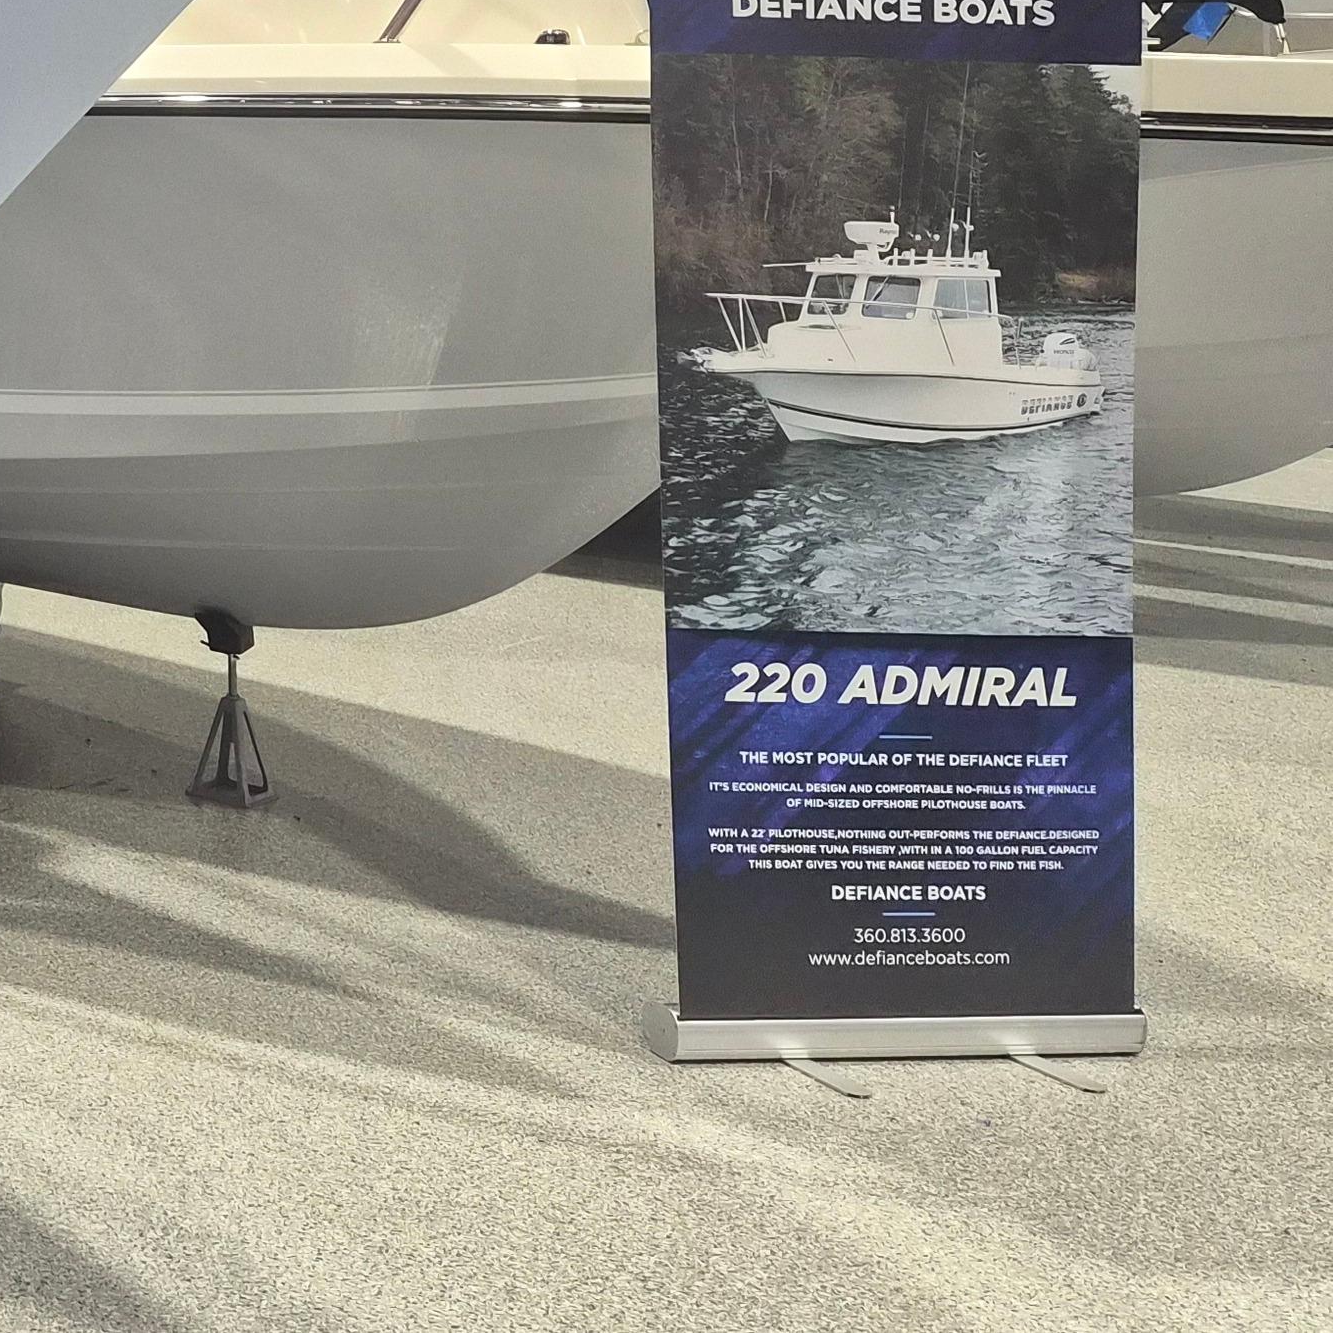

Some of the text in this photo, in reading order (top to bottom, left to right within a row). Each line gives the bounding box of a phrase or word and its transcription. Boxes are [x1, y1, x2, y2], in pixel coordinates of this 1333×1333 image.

[724, 662, 1077, 707] 220 ADMIRAL
[740, 751, 1069, 767] THE MOST POPULAR OF THE DEFIANCE FLEET
[709, 781, 1097, 795] IT'S ECONOMICAL DESIGN AND COMFORTABLE NO-FRILLS IS THE PINNACLE
[786, 798, 1026, 810] OF MID-SIZED OFFSHORE PILOTHOUSE BOATS.
[708, 828, 738, 838] WITH
[740, 828, 749, 838] A
[888, 829, 971, 840] OUT-PERFORMS
[973, 830, 993, 840] THE
[710, 843, 733, 854] FOR
[736, 843, 757, 854] THE
[760, 844, 817, 854] OFFSHORE
[819, 845, 850, 855] TUNA
[931, 845, 942, 855] IN
[944, 846, 953, 855] A
[955, 846, 974, 855] 100
[976, 846, 1019, 855] GALLON
[1021, 846, 1047, 855] FUEL
[1049, 845, 1098, 855] CAPACITY
[749, 859, 1064, 870] THIS BOAT GIVES YOU THE RANGE NEEDED TO FIND THE FISH.
[831, 884, 986, 901] DEFIANCE BOATS
[853, 927, 966, 944] 360.813.3600
[808, 949, 1010, 966] www.defianceboats.com
